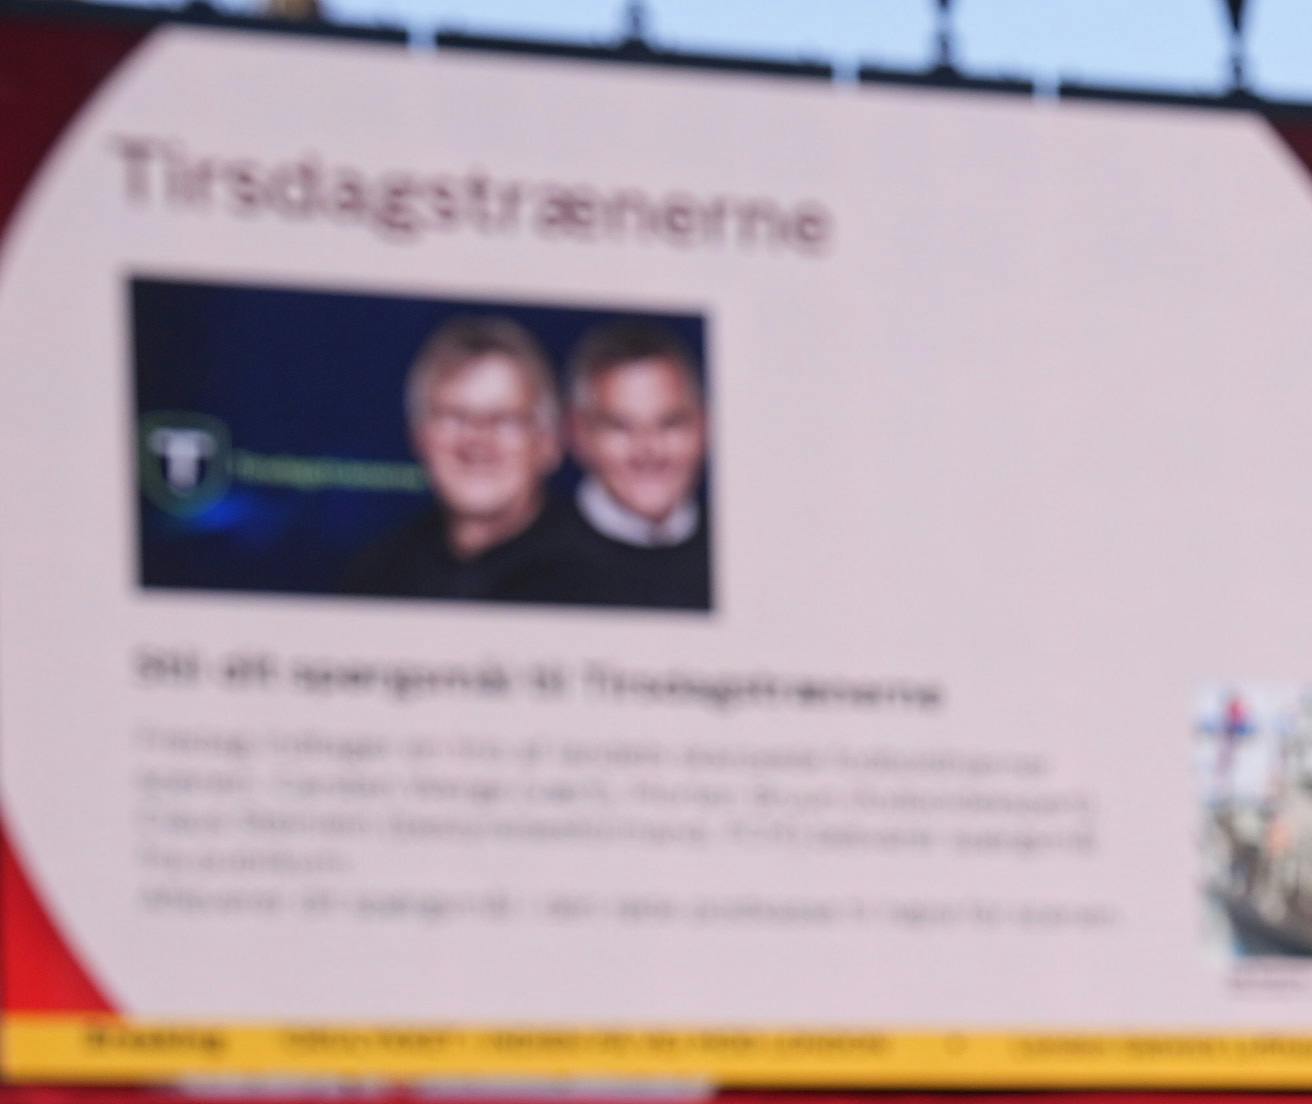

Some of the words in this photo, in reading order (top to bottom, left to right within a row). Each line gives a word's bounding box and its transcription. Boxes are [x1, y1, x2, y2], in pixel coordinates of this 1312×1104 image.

[107, 133, 834, 257] Tirsdagstrænerne
[151, 430, 213, 492] T
[580, 659, 945, 714] Tirsdagstrænerne
